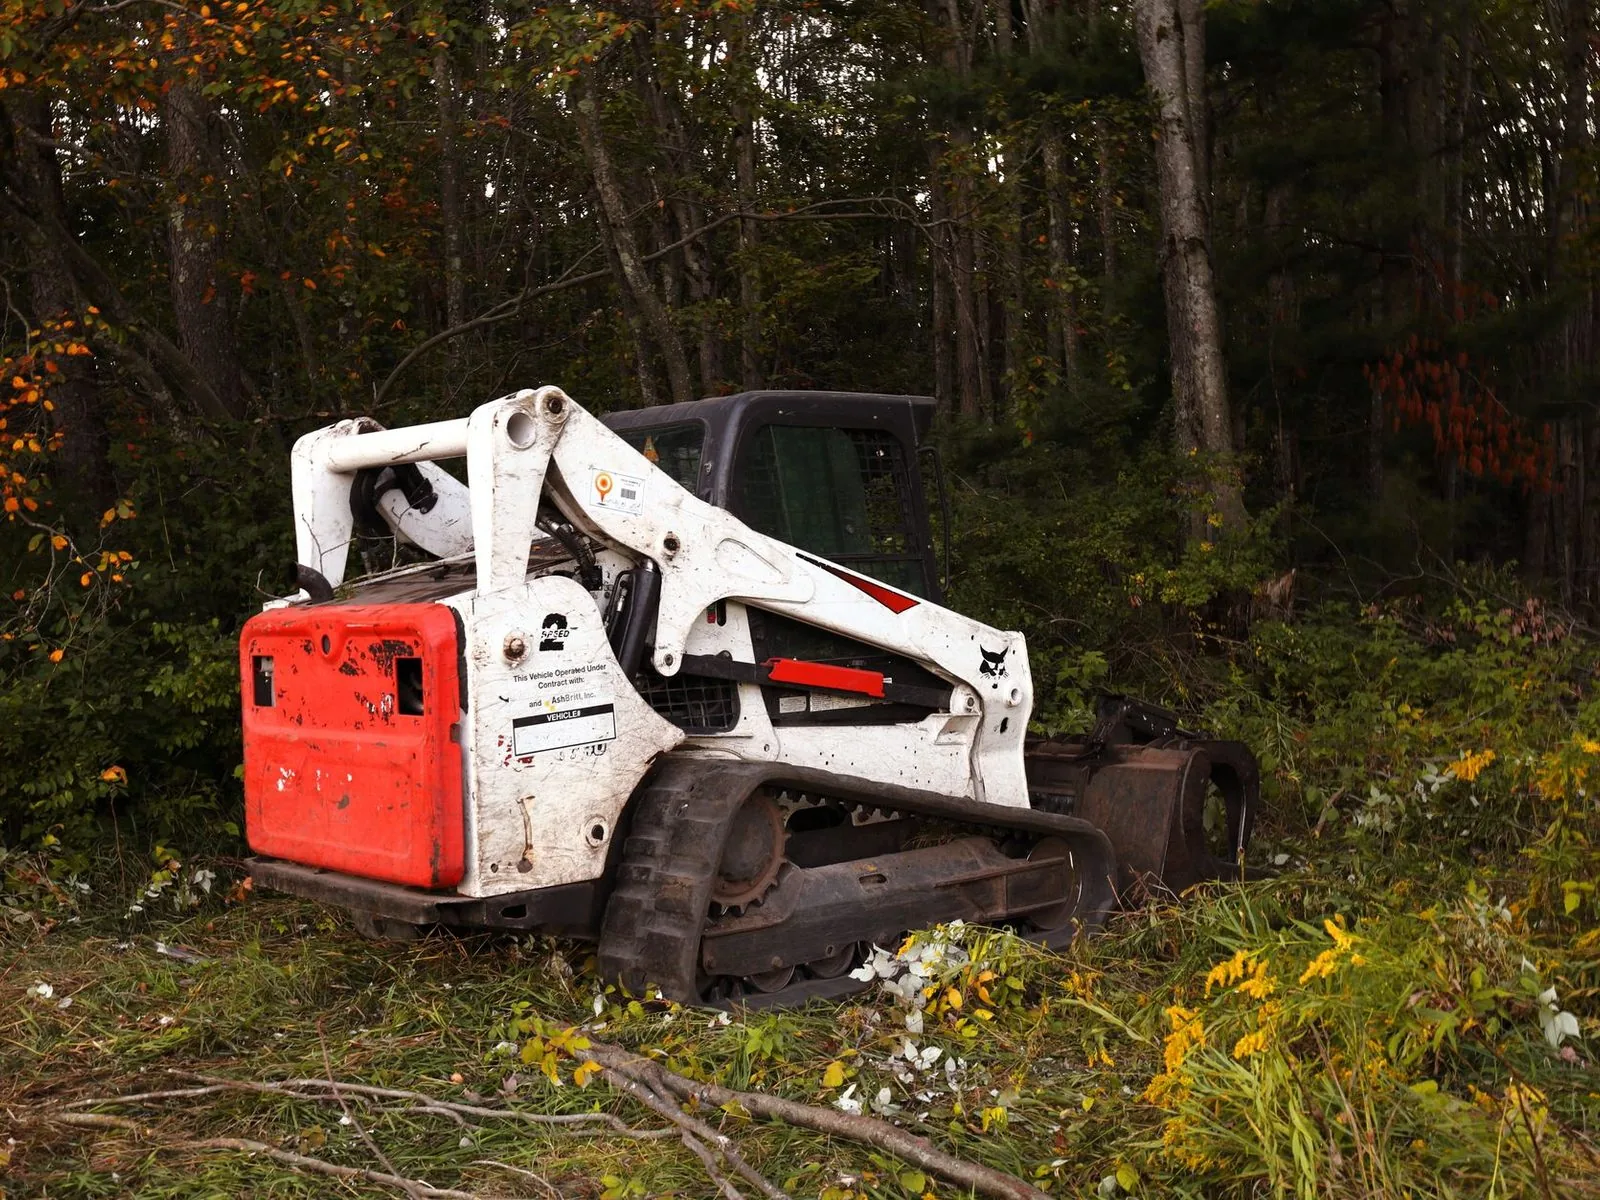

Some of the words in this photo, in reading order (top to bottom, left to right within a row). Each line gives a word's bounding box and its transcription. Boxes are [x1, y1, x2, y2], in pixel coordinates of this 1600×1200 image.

[539, 613, 568, 651] 2
[513, 675, 528, 683] This
[530, 671, 554, 681] Vehicle
[555, 666, 586, 678] Operated
[587, 663, 607, 672] Under
[538, 679, 568, 690] Contract
[569, 677, 585, 686] with:
[529, 699, 542, 708] and
[584, 691, 597, 700] Inc.
